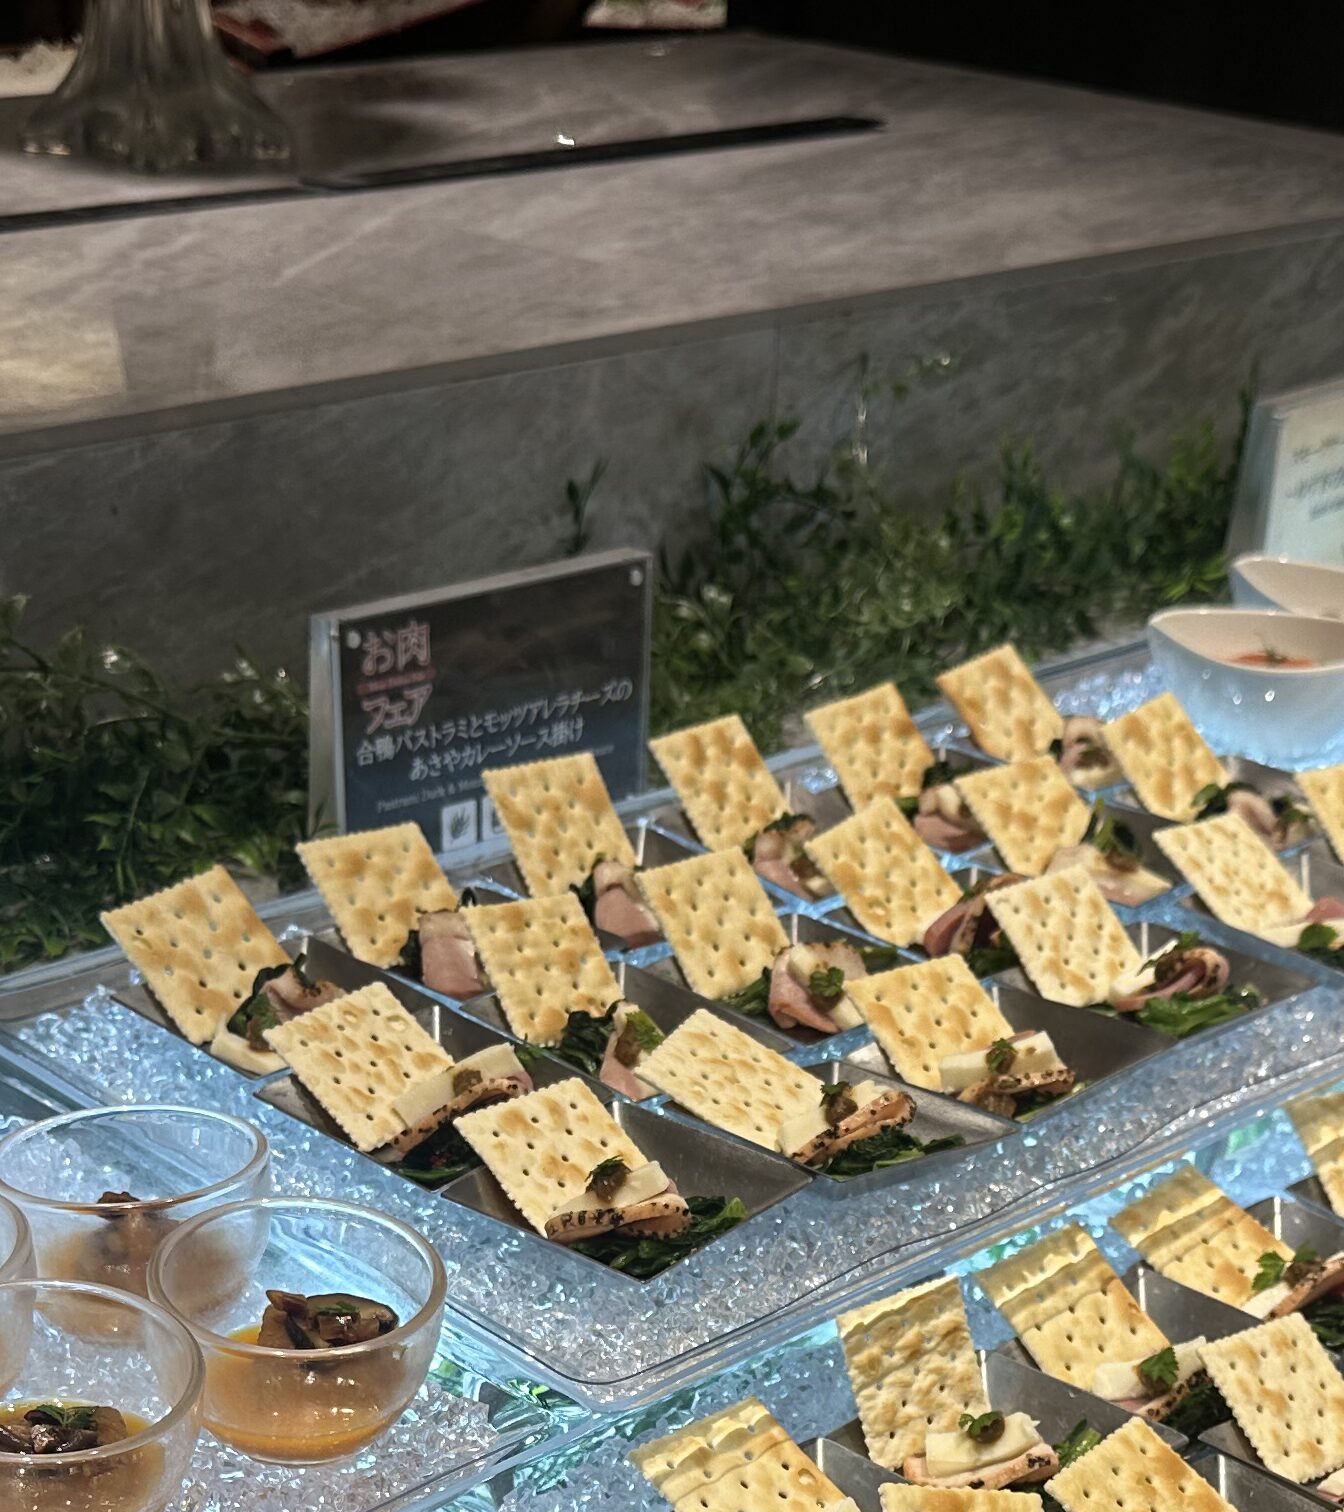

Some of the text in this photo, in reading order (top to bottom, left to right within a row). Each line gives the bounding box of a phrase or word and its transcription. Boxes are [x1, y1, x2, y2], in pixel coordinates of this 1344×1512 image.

[361, 620, 431, 676] お肉
[361, 683, 433, 735] フェア
